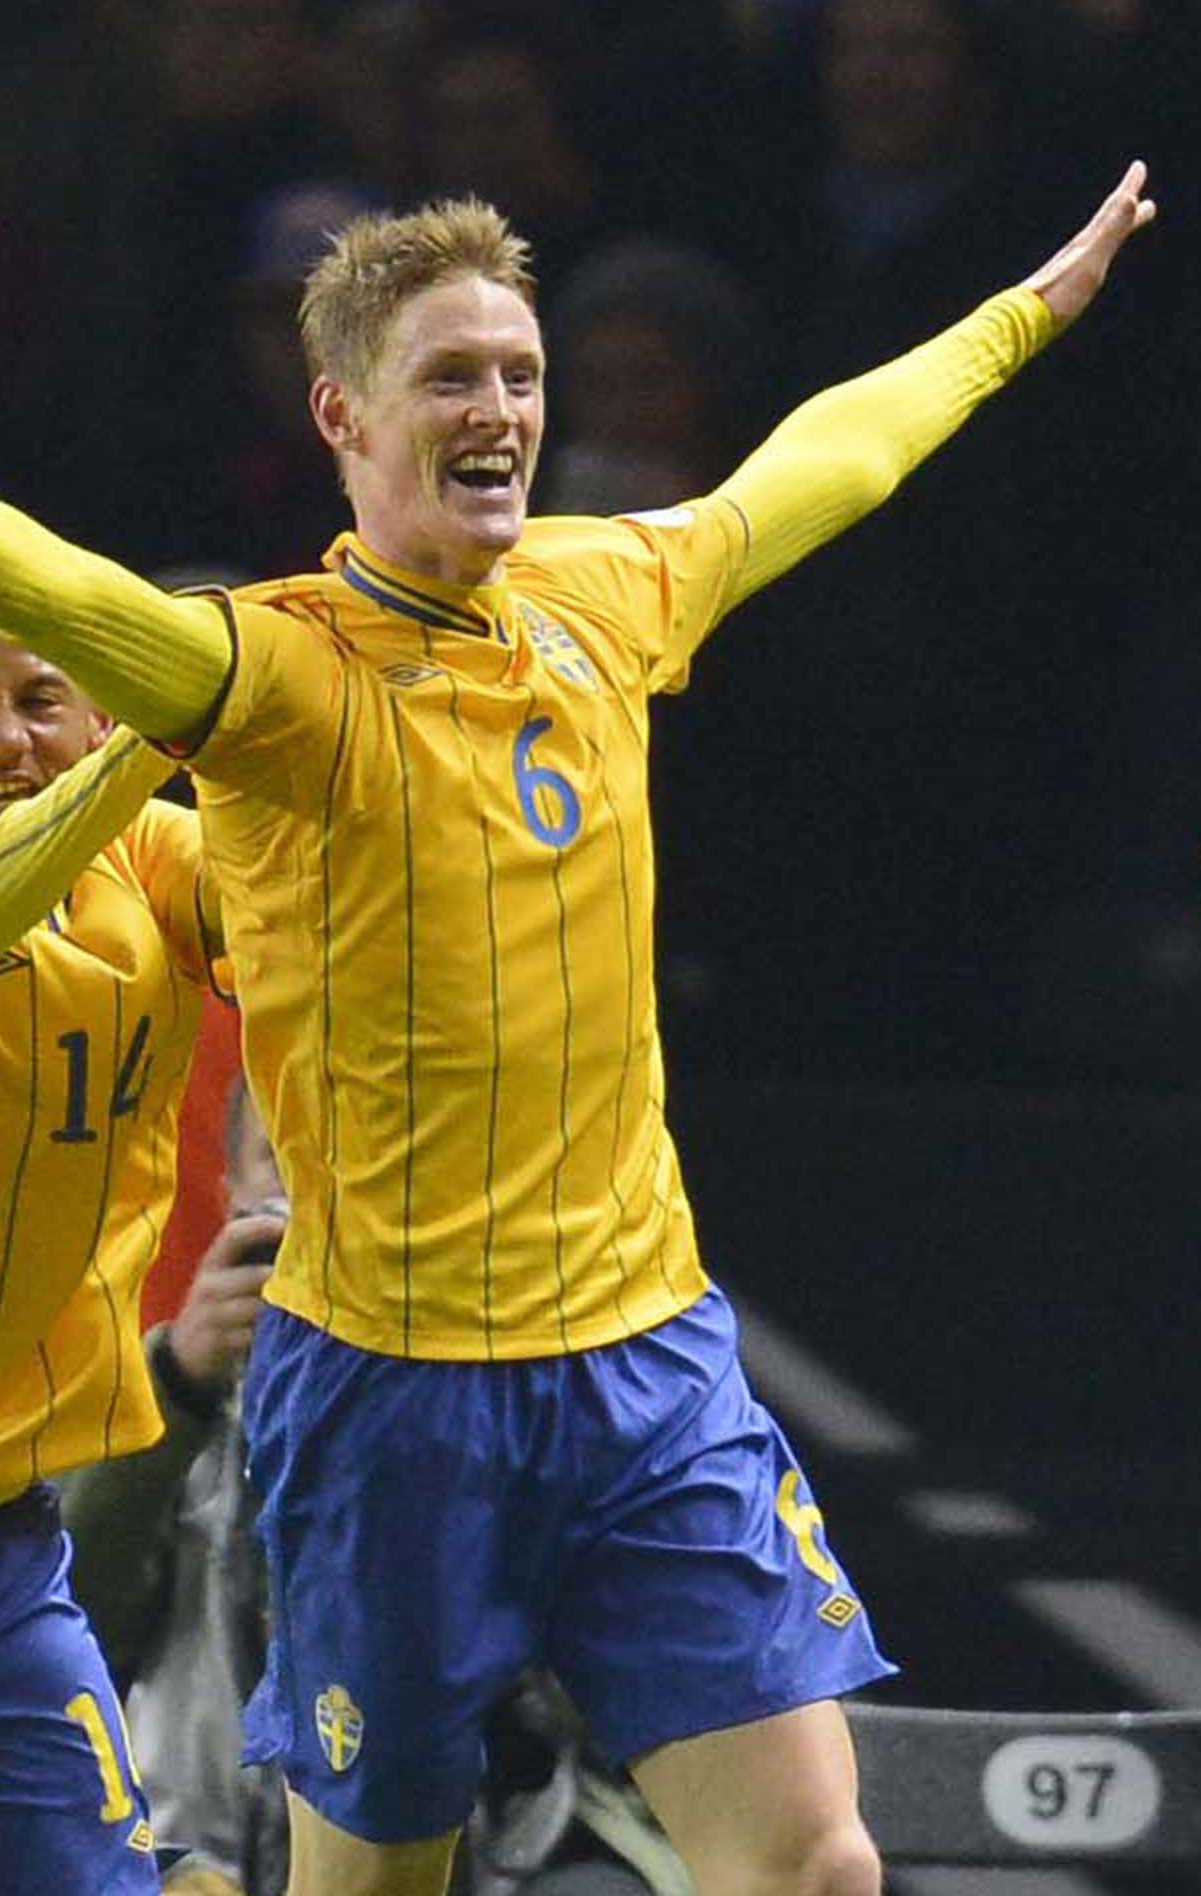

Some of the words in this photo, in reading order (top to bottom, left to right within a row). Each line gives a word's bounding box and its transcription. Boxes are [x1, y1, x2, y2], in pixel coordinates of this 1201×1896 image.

[513, 715, 582, 848] 6
[50, 1015, 156, 1143] 14
[65, 1692, 141, 1823] 1
[1026, 1763, 1117, 1819] 97
